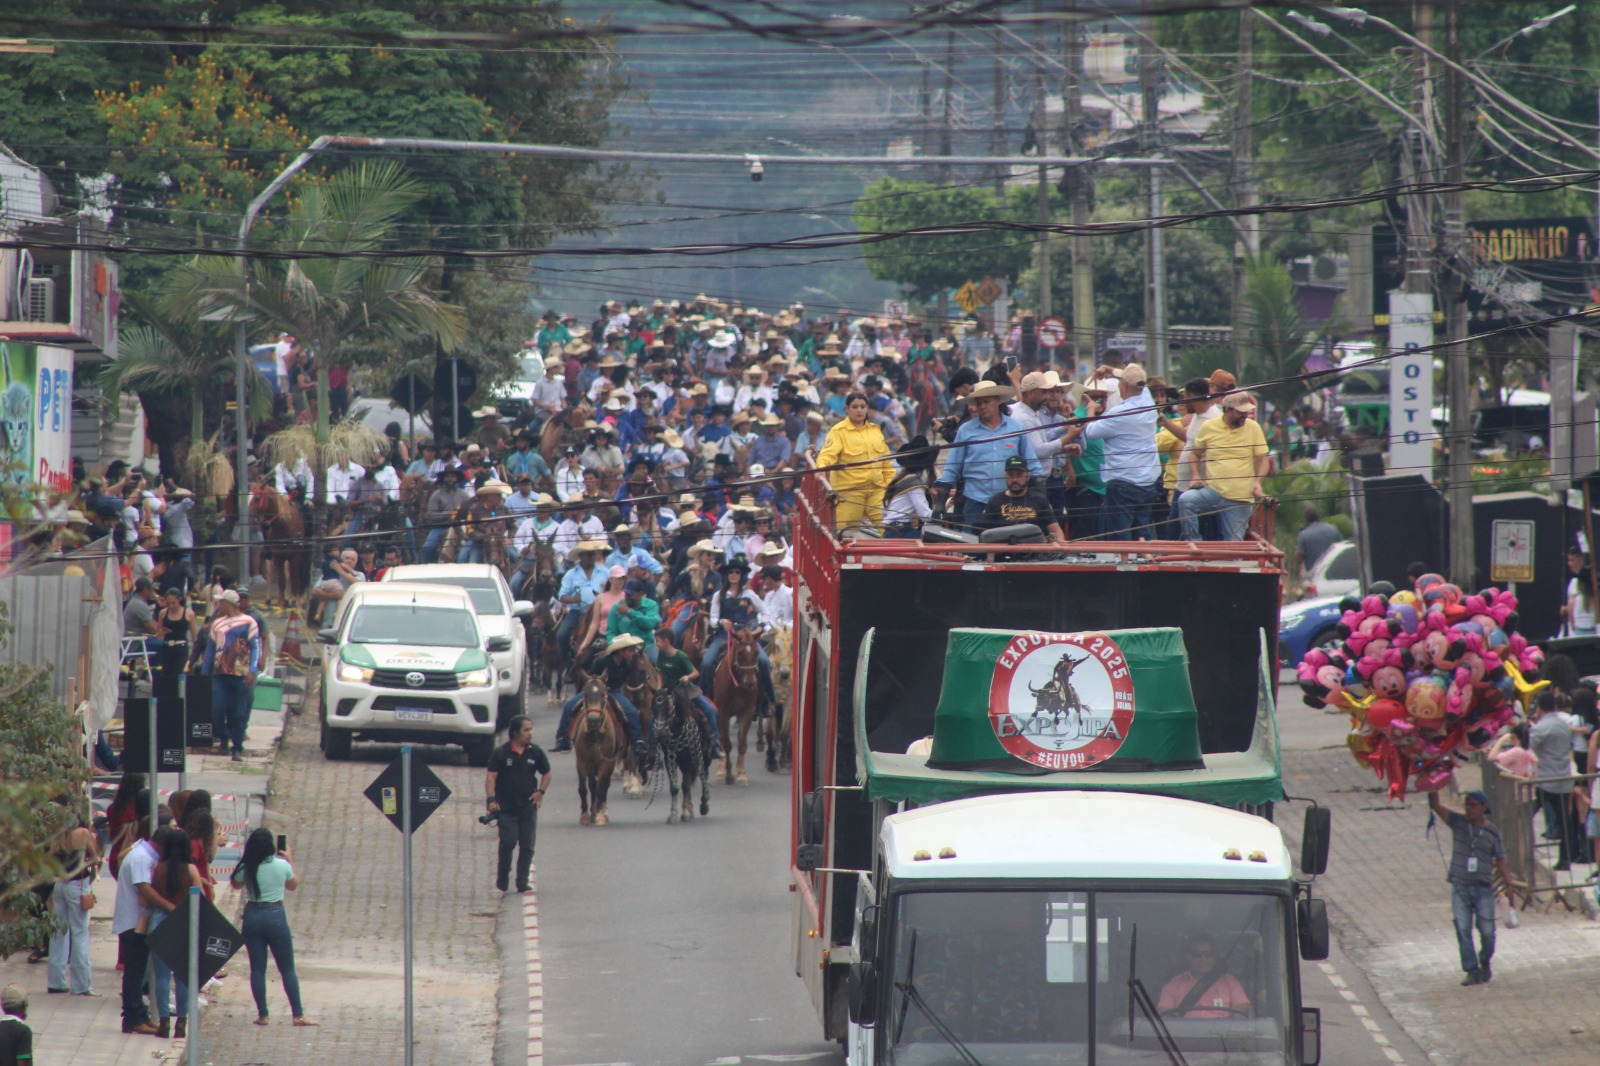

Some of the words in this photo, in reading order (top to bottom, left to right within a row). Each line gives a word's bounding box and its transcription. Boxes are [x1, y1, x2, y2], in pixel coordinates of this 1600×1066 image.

[39, 367, 69, 433] PET
[1404, 341, 1420, 445] POSTO
[1090, 637, 1128, 680] 2025
[1037, 752, 1085, 769] #EUVOU
